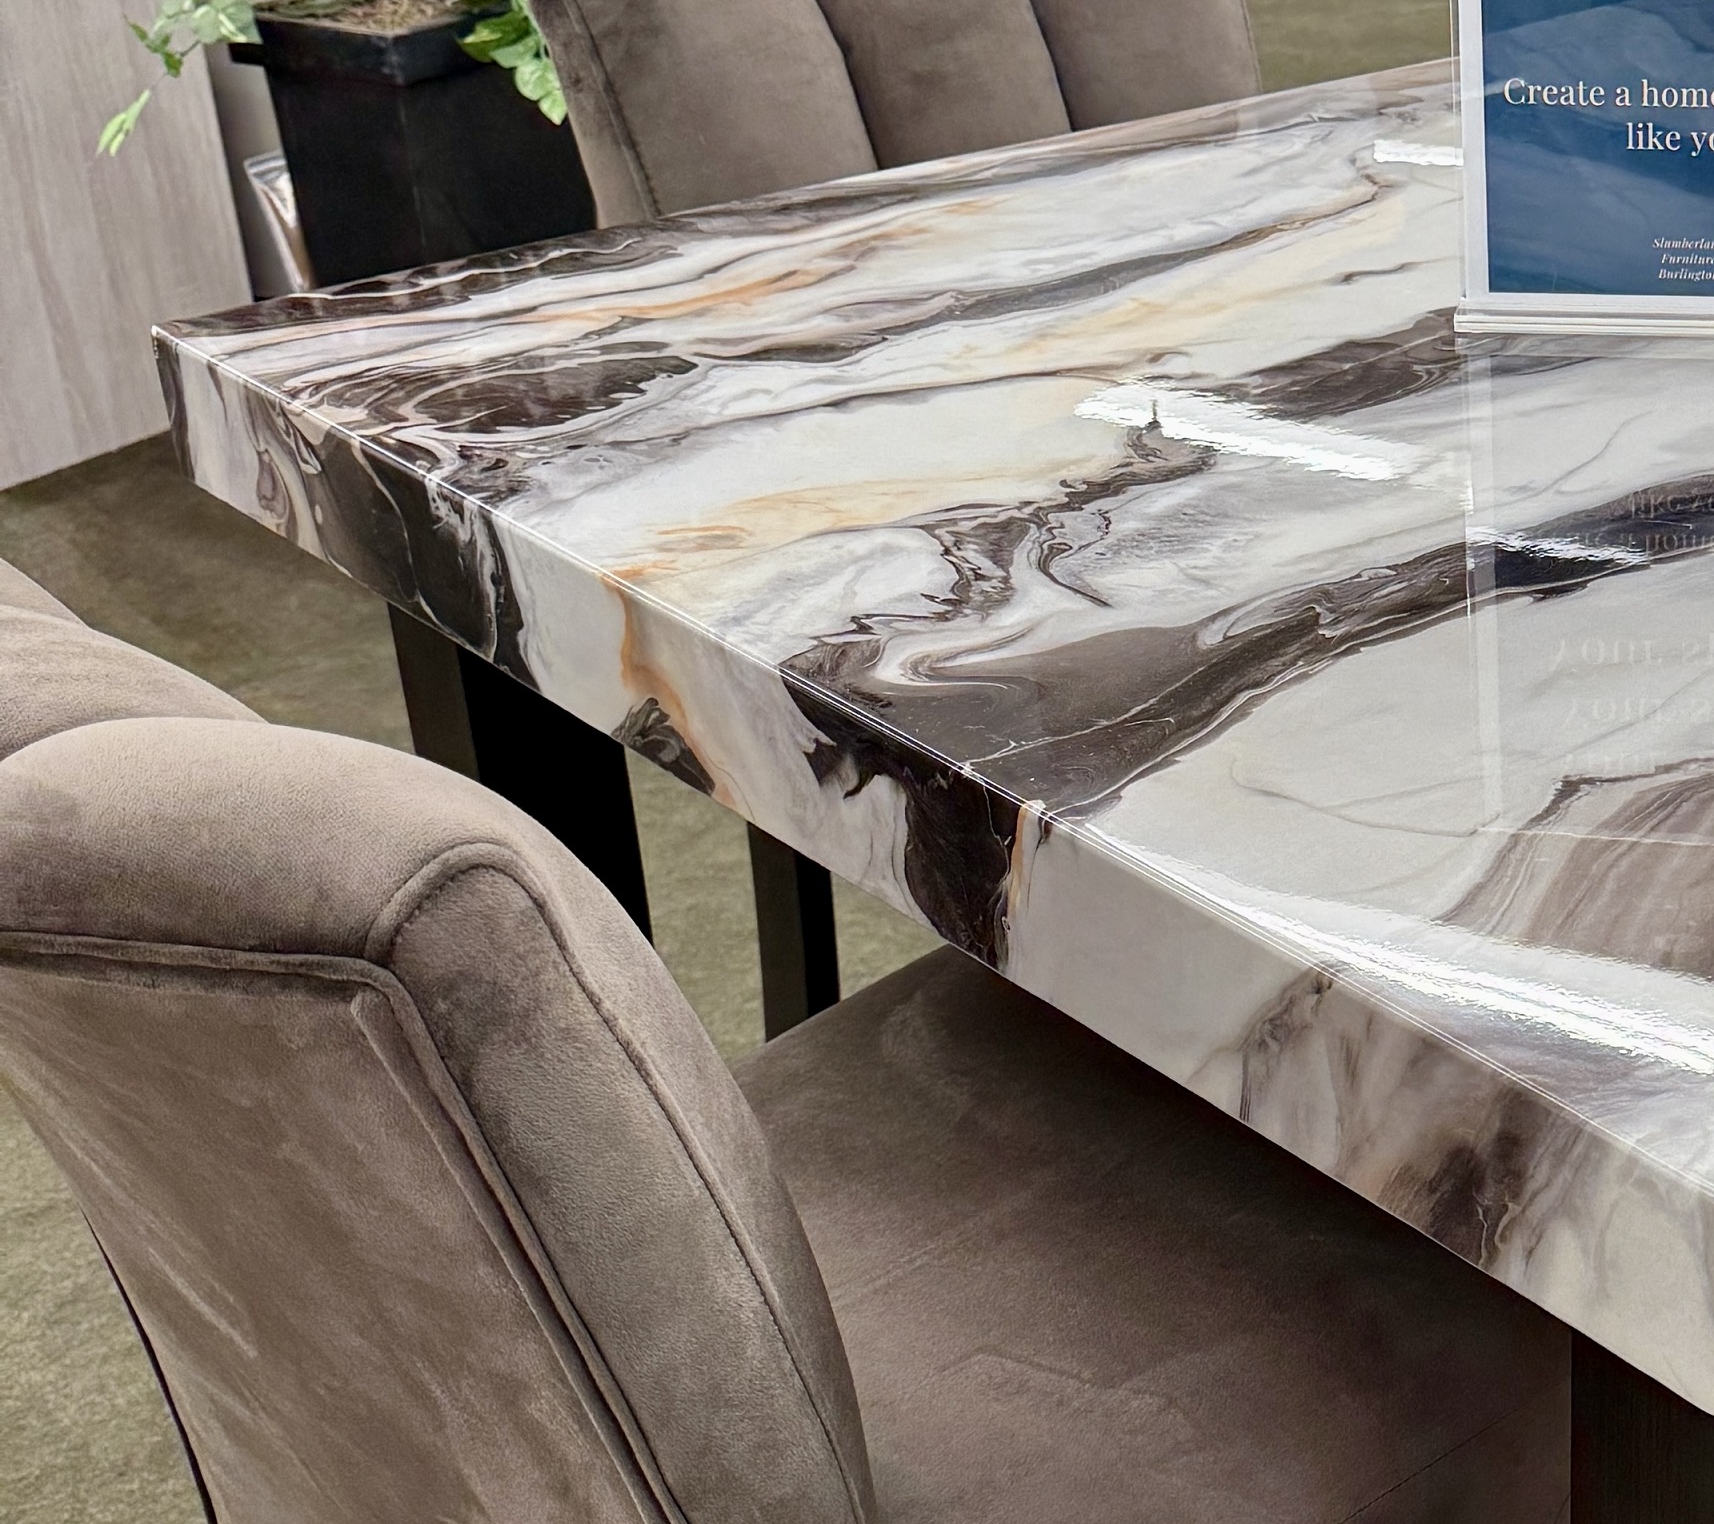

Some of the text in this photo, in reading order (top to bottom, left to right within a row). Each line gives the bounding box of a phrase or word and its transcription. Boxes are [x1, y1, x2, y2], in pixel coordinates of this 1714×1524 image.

[1503, 78, 1605, 107] Create
[1614, 85, 1633, 107] a
[1626, 122, 1682, 152] like
